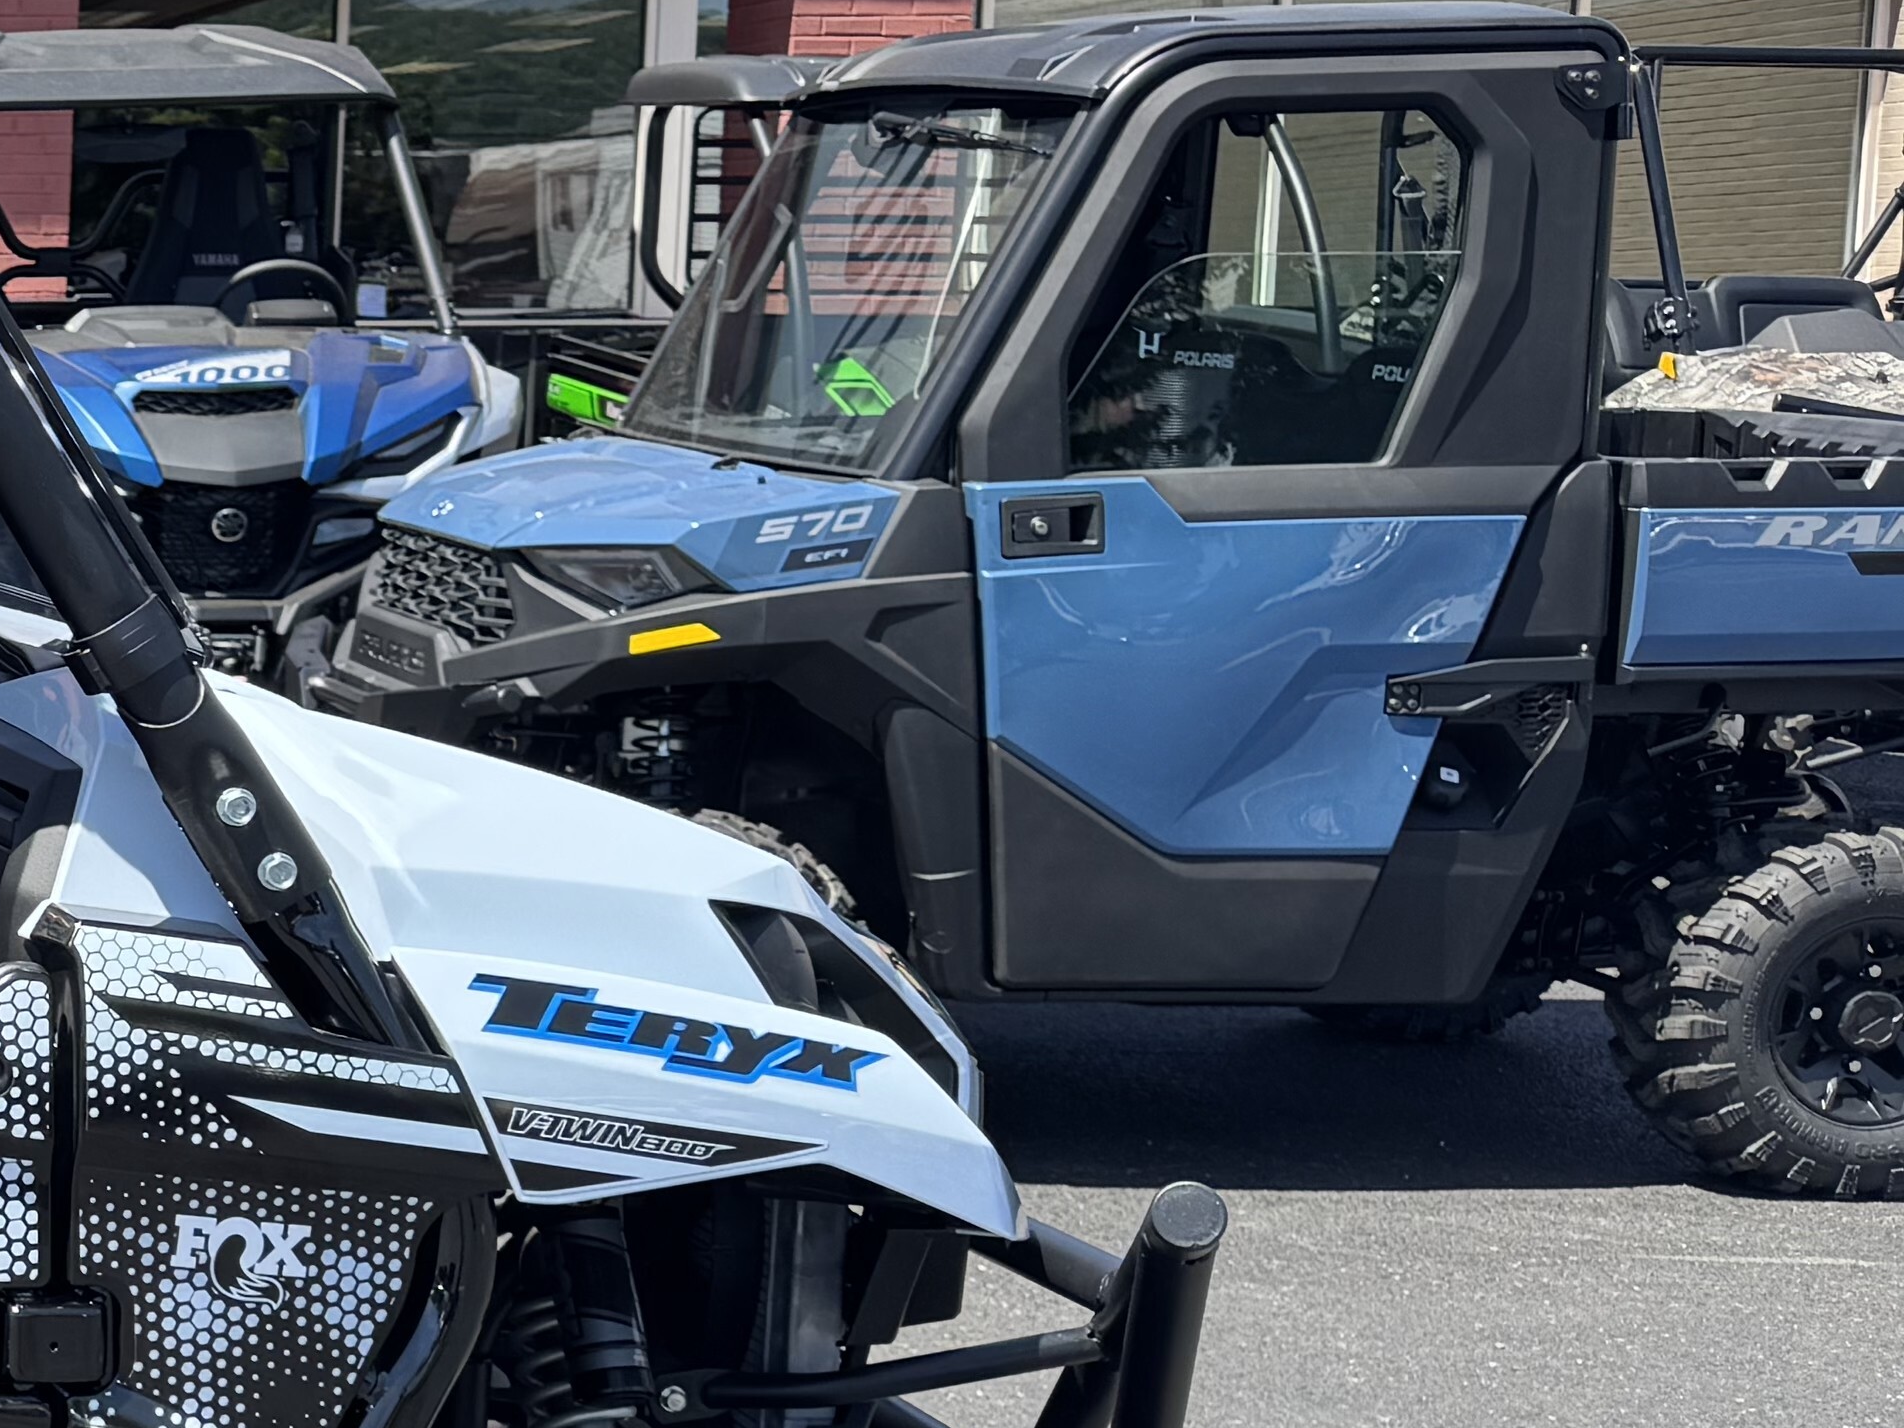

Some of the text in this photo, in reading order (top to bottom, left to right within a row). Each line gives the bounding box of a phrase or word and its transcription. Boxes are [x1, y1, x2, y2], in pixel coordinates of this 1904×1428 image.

[1172, 349, 1235, 370] POLARIS
[1371, 363, 1411, 383] POL
[756, 504, 874, 545] 570
[804, 548, 850, 564] EFI
[466, 972, 893, 1093] TERYX
[171, 1214, 308, 1310] FOX
